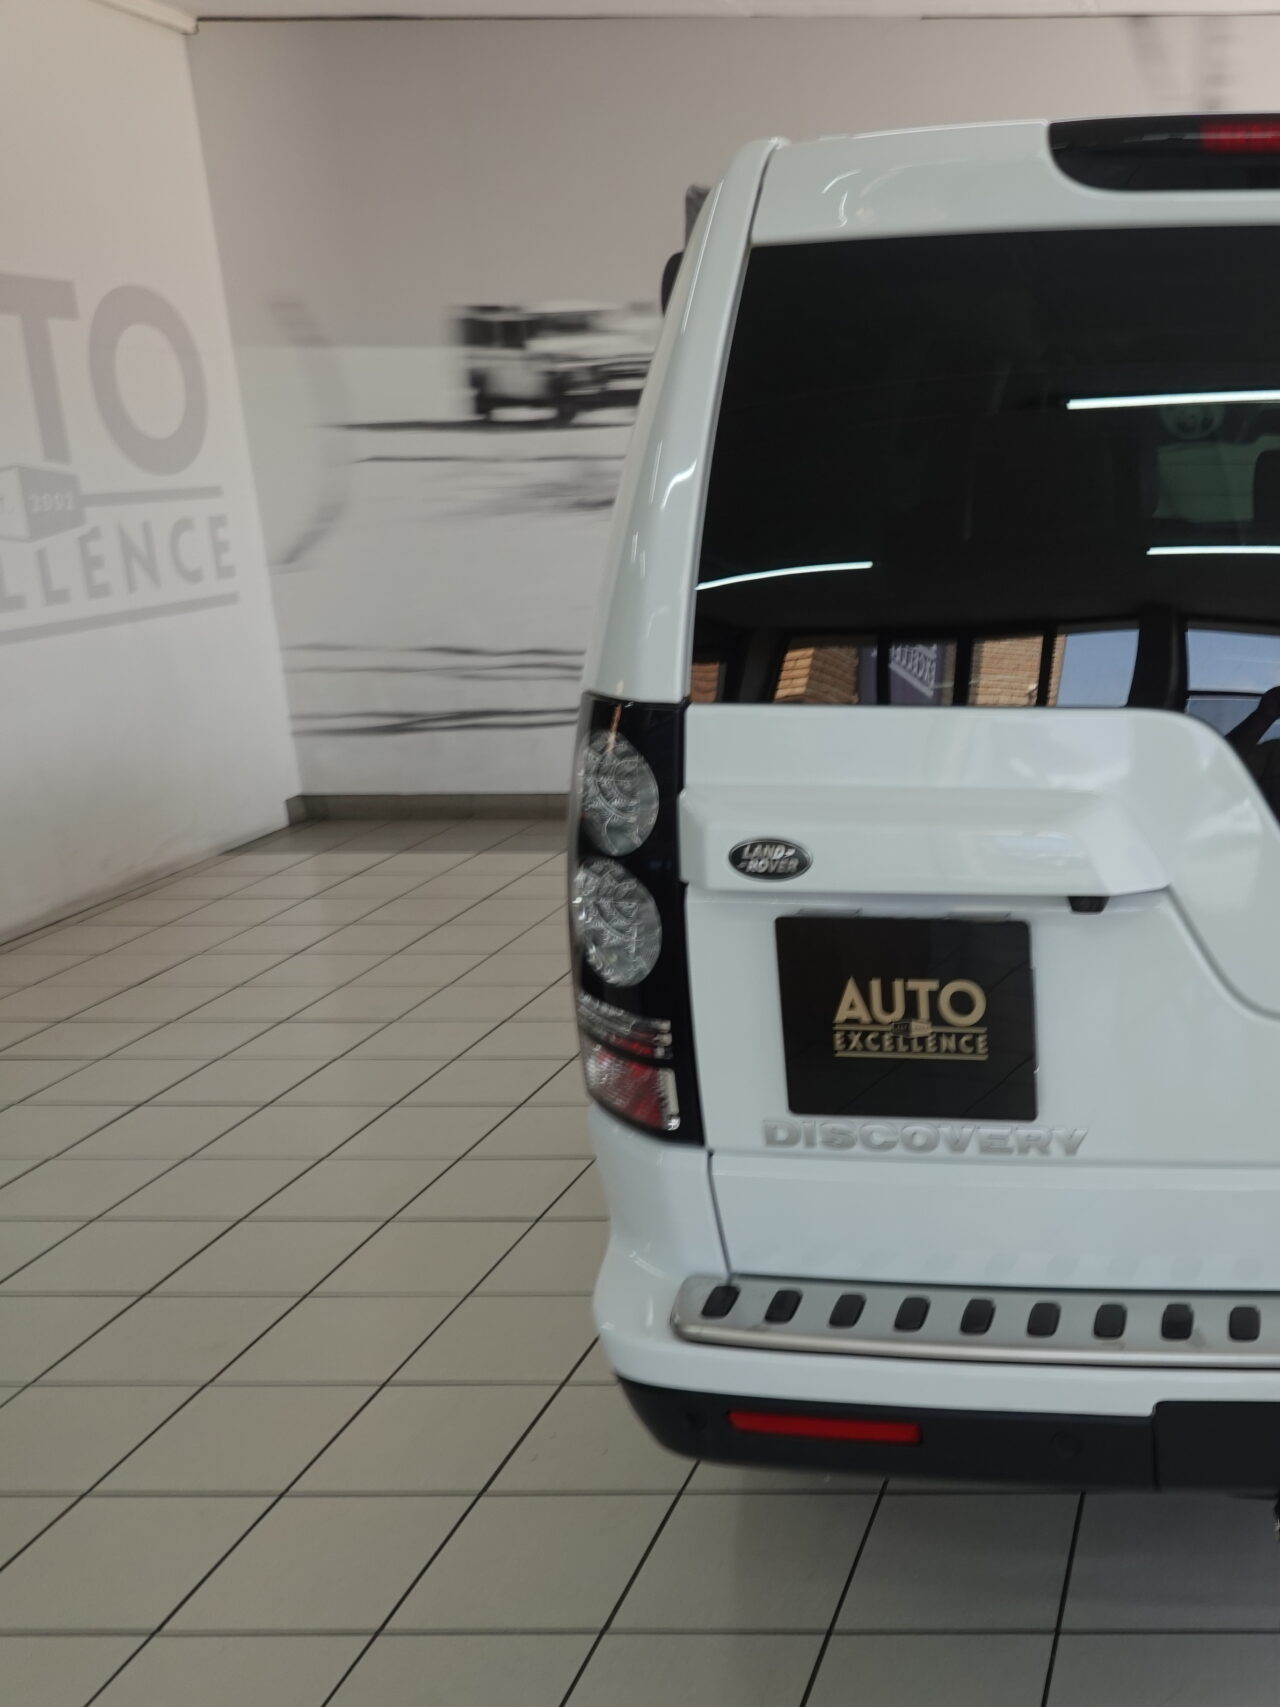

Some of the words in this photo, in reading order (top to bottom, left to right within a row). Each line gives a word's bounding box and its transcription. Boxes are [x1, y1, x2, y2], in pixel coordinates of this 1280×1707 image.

[741, 844, 786, 860] LAND
[745, 858, 800, 873] ROVER
[832, 976, 987, 1028] AUTO
[833, 1031, 989, 1054] EXCELLENCE
[762, 1119, 1089, 1157] DISCOVERY
